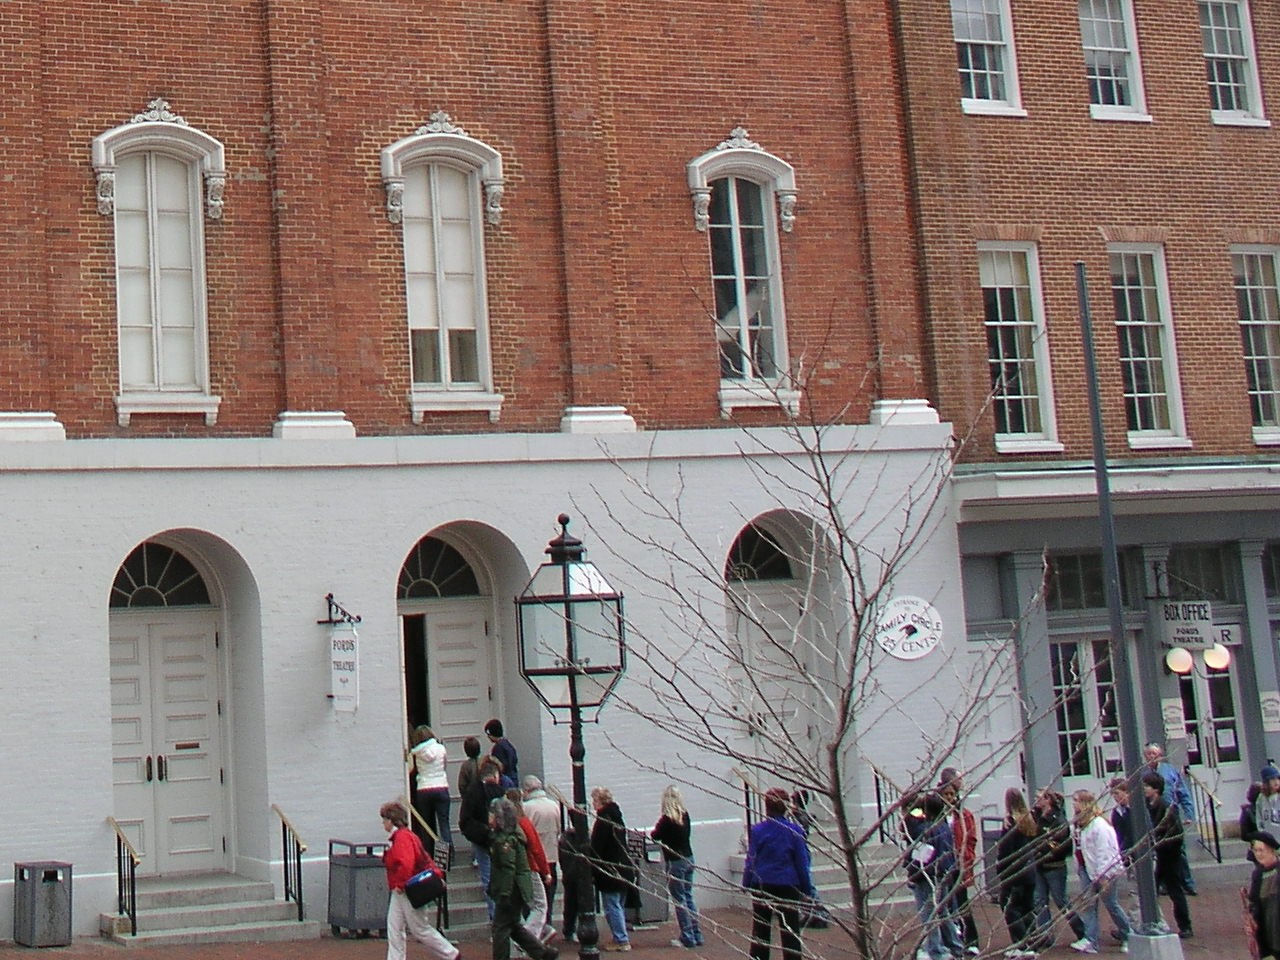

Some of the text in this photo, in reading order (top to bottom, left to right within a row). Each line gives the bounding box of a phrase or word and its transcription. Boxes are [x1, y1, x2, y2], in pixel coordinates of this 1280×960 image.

[1164, 603, 1209, 621] BOX OFFICE
[910, 613, 941, 632] CIRCLE
[901, 636, 937, 652] CENTS
